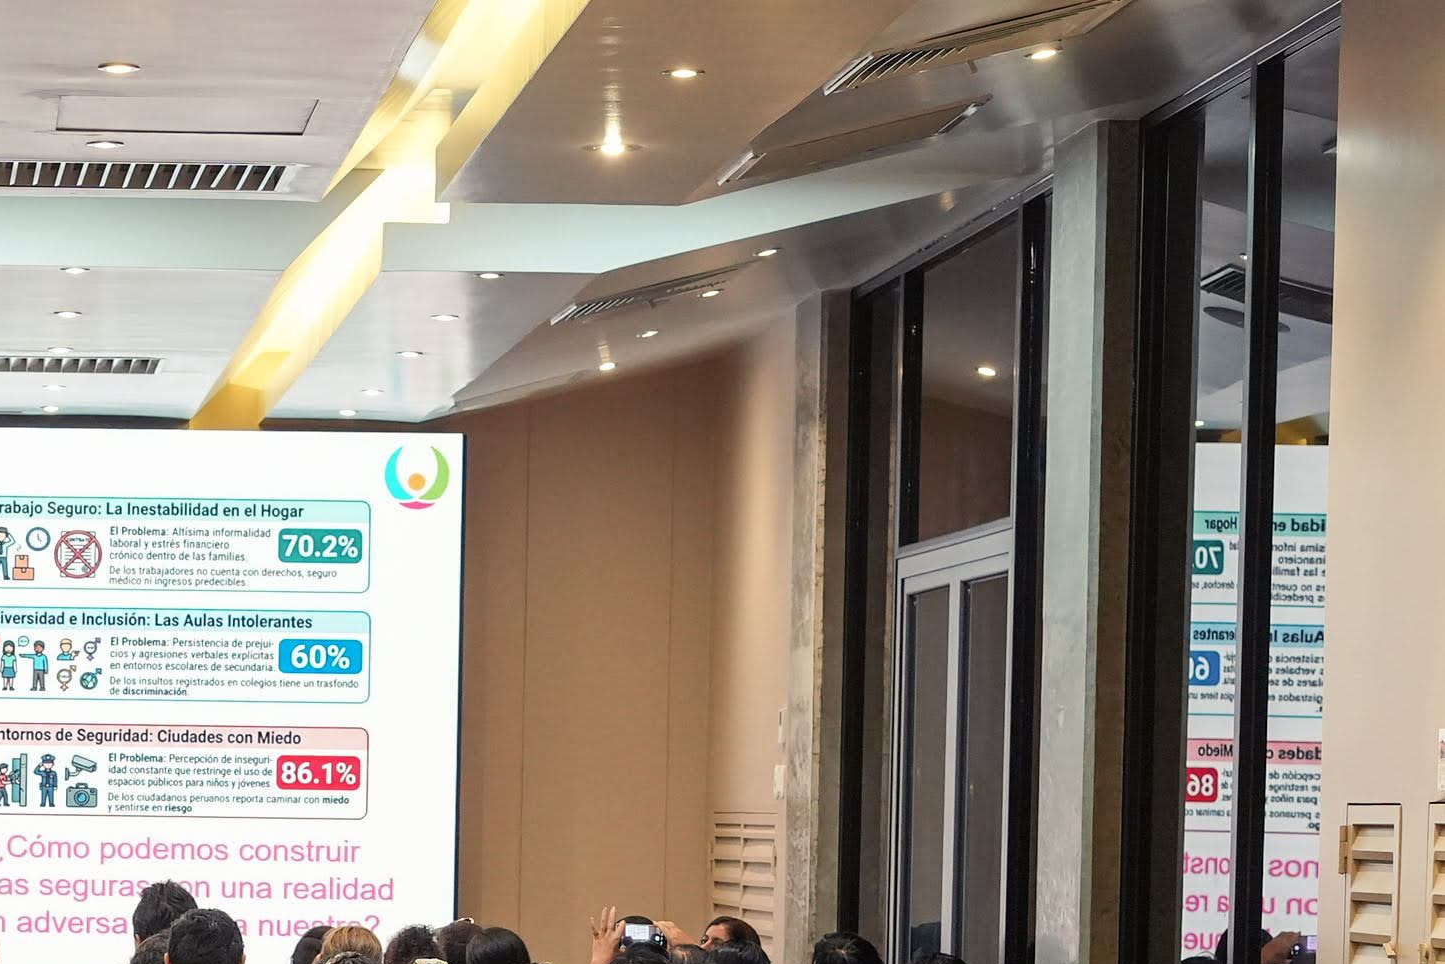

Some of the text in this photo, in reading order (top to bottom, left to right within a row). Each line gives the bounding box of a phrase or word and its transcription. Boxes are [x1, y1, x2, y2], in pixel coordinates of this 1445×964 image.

[47, 501, 101, 518] Seguro:
[106, 501, 122, 515] La
[127, 501, 218, 516] Inestabilidad
[222, 506, 239, 517] en
[244, 503, 256, 517] el
[261, 504, 304, 521] Hogar
[109, 525, 271, 538] El Problema: Altísima informalidad
[109, 538, 229, 550] laboral y estrés financiero
[282, 534, 358, 558] 70.2%
[69, 615, 77, 625] e
[81, 611, 150, 626] Inclusión:
[154, 613, 179, 626] Las
[183, 612, 223, 627] Aulas
[227, 613, 312, 628] Intolerantes
[291, 644, 350, 668] 60%
[122, 661, 162, 670] entornos
[164, 661, 208, 671] escolares
[210, 662, 221, 671] de
[224, 662, 275, 672] secundaria.
[109, 686, 187, 696] de discriminación.
[55, 727, 72, 741] de
[76, 727, 153, 745] Seguridad:
[157, 729, 223, 743] Ciudades
[227, 733, 253, 744] con
[257, 730, 301, 744] Miedo
[108, 752, 272, 766] El Problema: Percepción de inseguri-
[281, 761, 356, 784] 86.1%
[107, 792, 119, 801] De
[121, 792, 134, 804] los
[136, 792, 187, 805] ciudadanos
[189, 795, 230, 804] peruanos
[232, 795, 263, 804] reporta
[303, 796, 319, 804] con
[322, 794, 349, 804] miedo
[100, 836, 229, 866] podemos
[238, 838, 360, 863] construir
[221, 880, 272, 899] una
[283, 876, 394, 901] realidad
[16, 910, 127, 934] adversa
